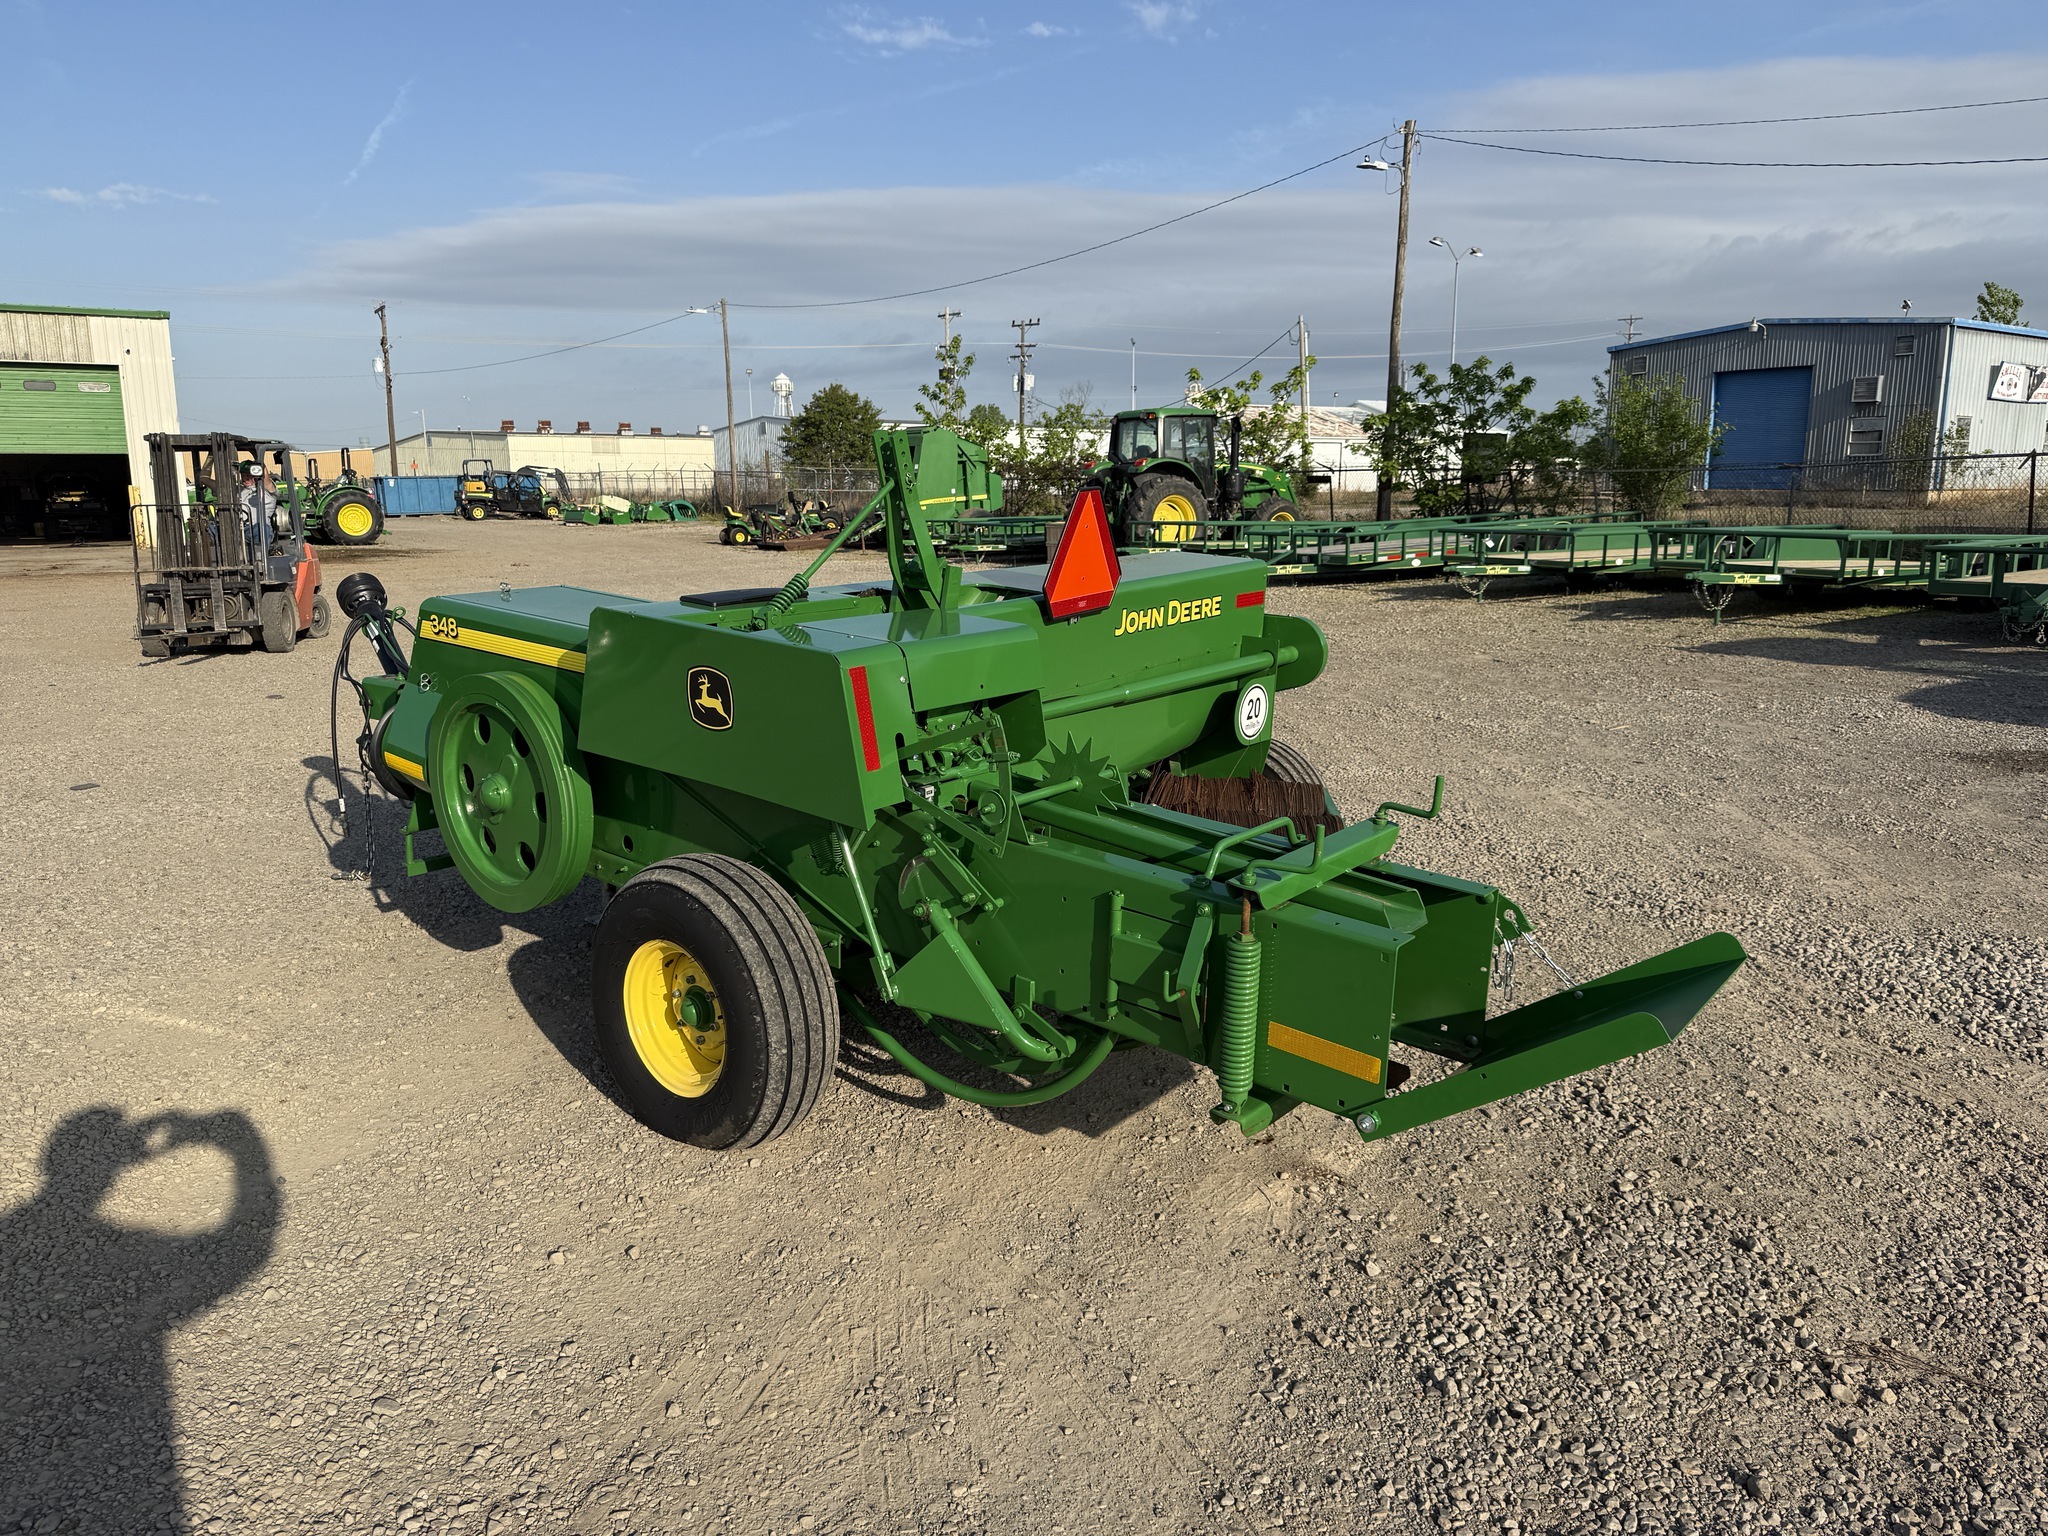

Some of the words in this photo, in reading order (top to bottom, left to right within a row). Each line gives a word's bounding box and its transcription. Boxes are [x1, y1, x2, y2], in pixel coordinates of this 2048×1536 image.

[430, 614, 458, 638] 348
[1114, 607, 1165, 636] JOHN
[1167, 595, 1222, 626] DEERE
[1246, 697, 1260, 720] 20
